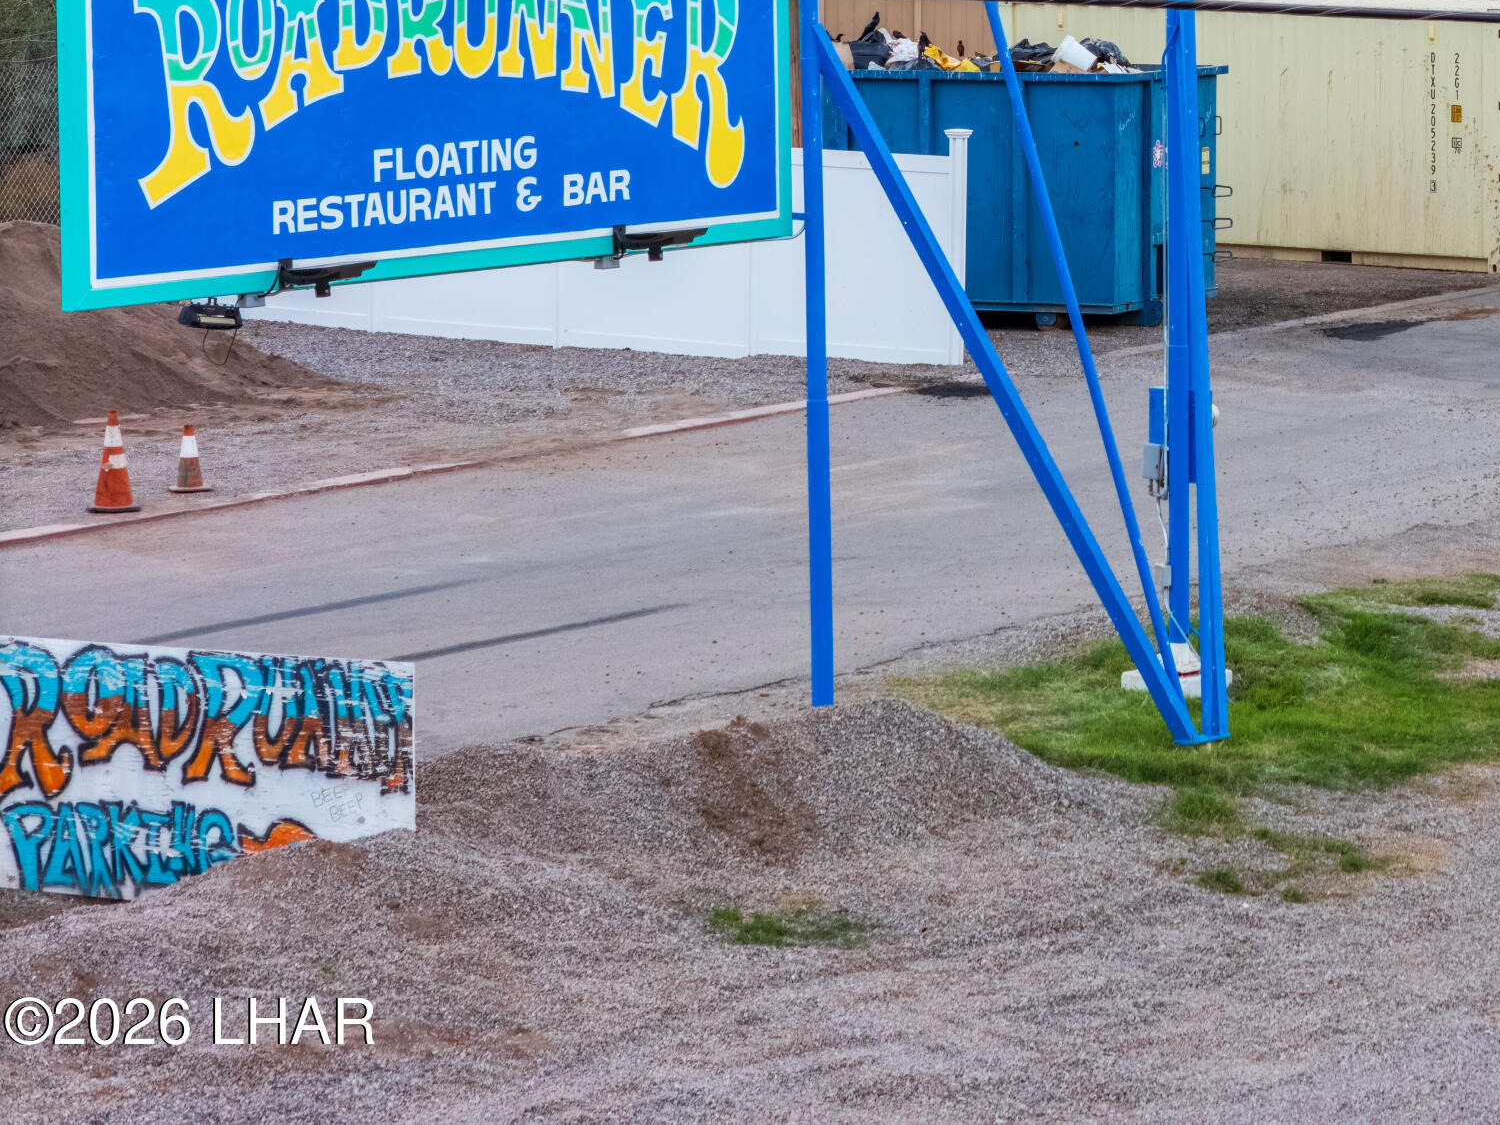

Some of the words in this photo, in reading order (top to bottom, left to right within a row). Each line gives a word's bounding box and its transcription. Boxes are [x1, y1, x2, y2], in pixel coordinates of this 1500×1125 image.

[373, 135, 538, 183] FLOATING
[272, 181, 497, 235] RESTAURANT
[516, 176, 542, 213] &
[563, 169, 631, 207] BAR
[311, 785, 343, 809] BEE
[329, 792, 363, 822] BEEP
